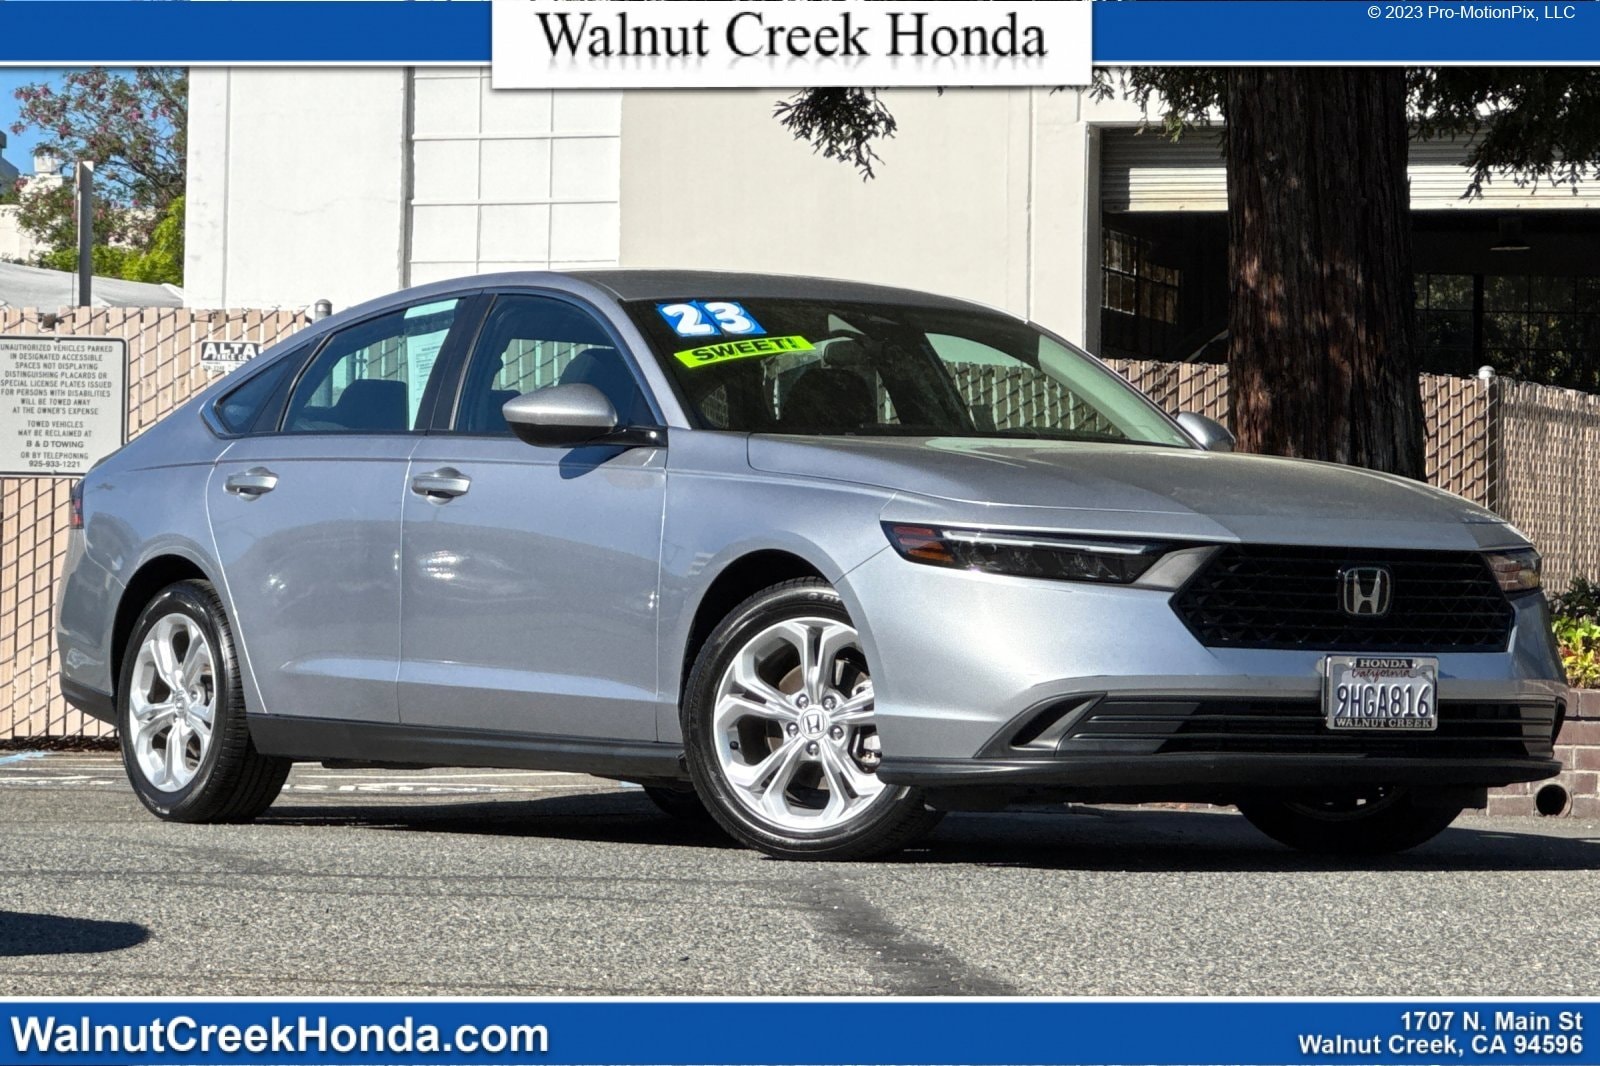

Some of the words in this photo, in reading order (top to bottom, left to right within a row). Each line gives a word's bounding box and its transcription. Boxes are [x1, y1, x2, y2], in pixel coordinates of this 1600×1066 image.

[662, 302, 751, 335] 23
[203, 342, 257, 359] ALTA
[691, 338, 797, 361] SWEET!
[19, 353, 60, 361] DESIGNATED
[5, 370, 58, 379] DISTINGUISHING
[60, 371, 96, 379] PLACARDS
[0, 379, 28, 387] SPECIAL
[60, 380, 85, 388] PLATES
[49, 398, 72, 406] TOWED
[27, 420, 50, 428] TOWED
[51, 420, 84, 428] VEHICLES
[20, 451, 30, 459] OR
[28, 460, 81, 468] 925-933-1221
[1360, 659, 1409, 668] HONDA
[1336, 684, 1432, 717] 9HGA816
[1336, 718, 1386, 727] WALNUT
[1388, 718, 1431, 727] CREEK
